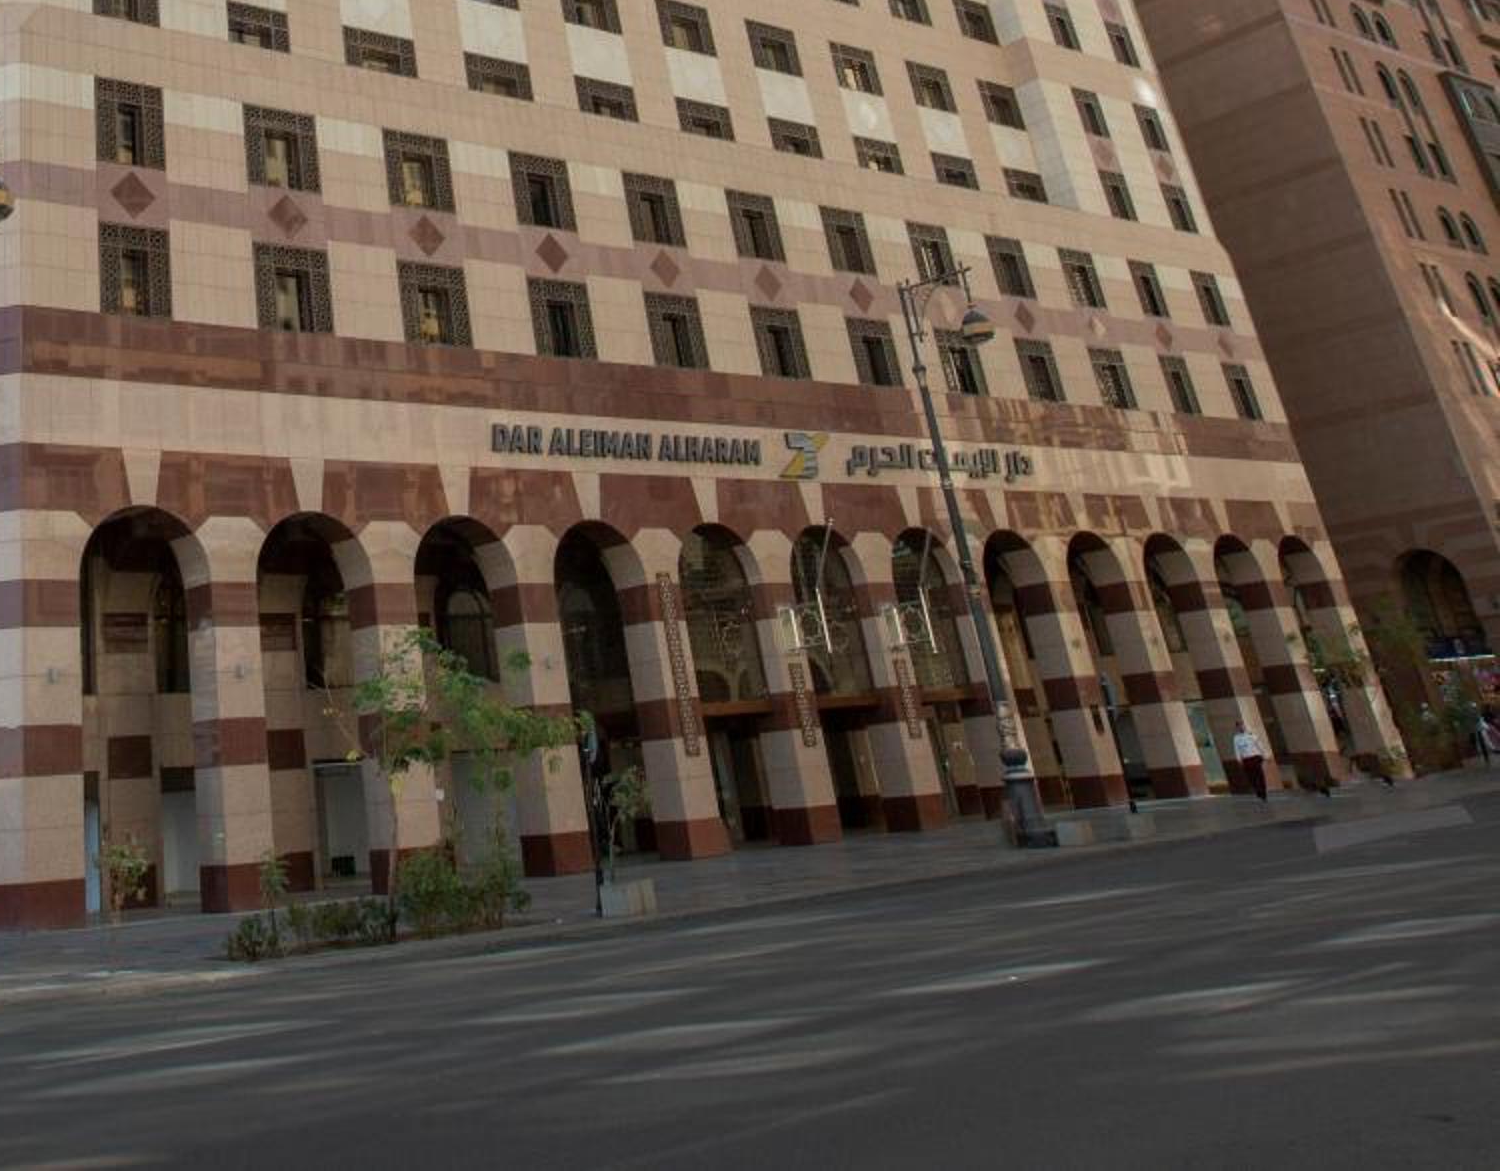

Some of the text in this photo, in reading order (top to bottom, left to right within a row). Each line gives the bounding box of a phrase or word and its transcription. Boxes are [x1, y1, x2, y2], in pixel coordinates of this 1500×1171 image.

[491, 423, 761, 466] DAR ALEIMAN ALHARAM
[846, 443, 1034, 483] دار الإيمن الحرم
